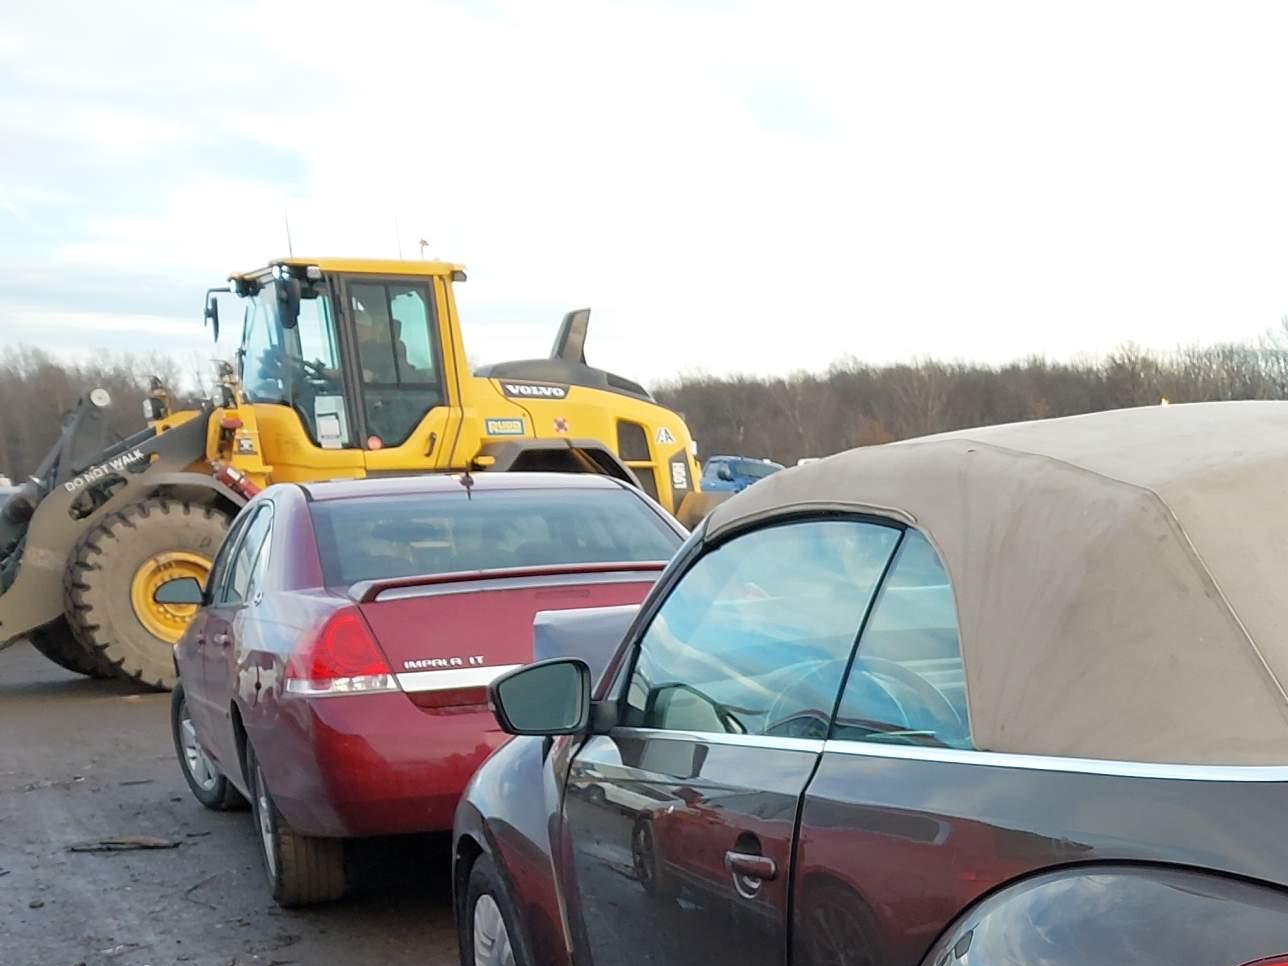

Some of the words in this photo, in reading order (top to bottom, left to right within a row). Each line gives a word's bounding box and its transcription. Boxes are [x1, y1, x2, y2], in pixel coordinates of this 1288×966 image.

[505, 384, 565, 397] VOLVO
[65, 477, 83, 492] DO
[83, 465, 109, 483] NOT
[110, 449, 145, 471] WALK
[404, 658, 462, 669] IMPALA
